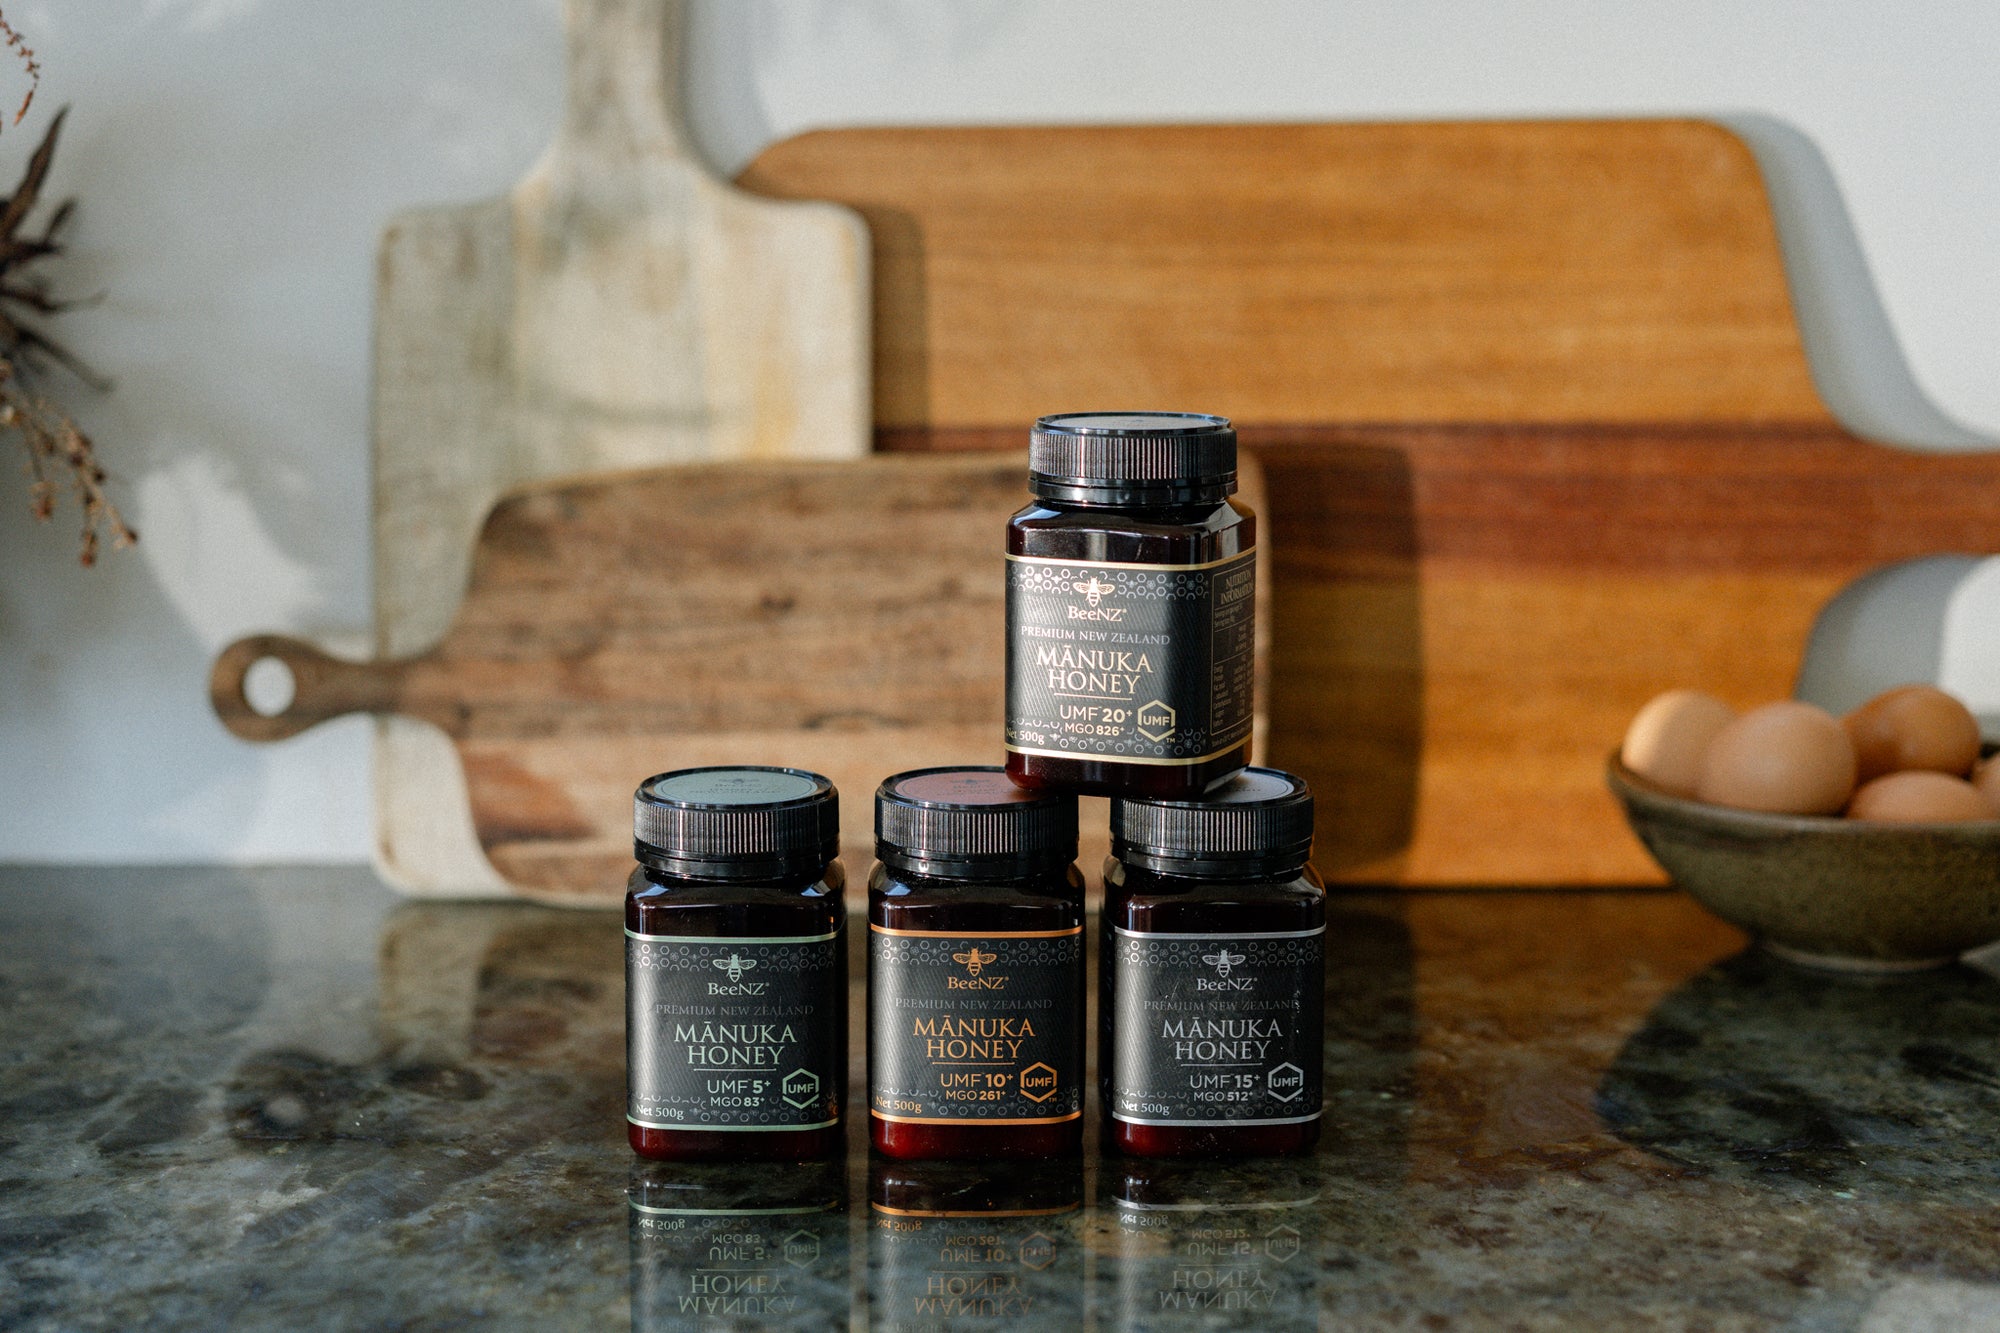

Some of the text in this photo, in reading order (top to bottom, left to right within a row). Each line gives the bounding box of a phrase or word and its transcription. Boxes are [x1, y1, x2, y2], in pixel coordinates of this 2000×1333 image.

[1021, 625, 1171, 645] PREMIUM NEW ZEALAND
[1036, 645, 1154, 673] MĀNUKA
[1047, 669, 1141, 695] HONEY
[1059, 704, 1102, 721] UMF
[1065, 722, 1094, 735] MGO
[1143, 716, 1170, 726] UMF
[1006, 728, 1045, 745] Net 500g
[655, 1003, 814, 1016] PREMIUM NEW ZEALAND
[895, 997, 1052, 1010] PREMIUM NEW ZEALAND
[1143, 999, 1300, 1012] PREMIUM NEW ZEALAND
[674, 1021, 797, 1044] MĀNUKA
[913, 1015, 1036, 1038] MĀNUKA
[1161, 1016, 1284, 1039] MĀNUKA
[687, 1045, 785, 1065] HONEY
[926, 1039, 1024, 1059] HONEY
[1175, 1040, 1272, 1061] HONEY
[707, 1079, 752, 1094] UMF
[940, 1072, 985, 1088] UMF
[1026, 1077, 1052, 1087] UMF
[1189, 1073, 1234, 1089] UMF
[1273, 1077, 1299, 1087] UMF
[788, 1084, 814, 1094] UMF
[946, 1090, 976, 1101] MGO
[1193, 1091, 1224, 1102] MGO
[710, 1096, 741, 1107] MGO
[875, 1096, 922, 1114] Net 500g
[1121, 1099, 1170, 1116] Net 500g
[635, 1104, 684, 1120] Net 500g
